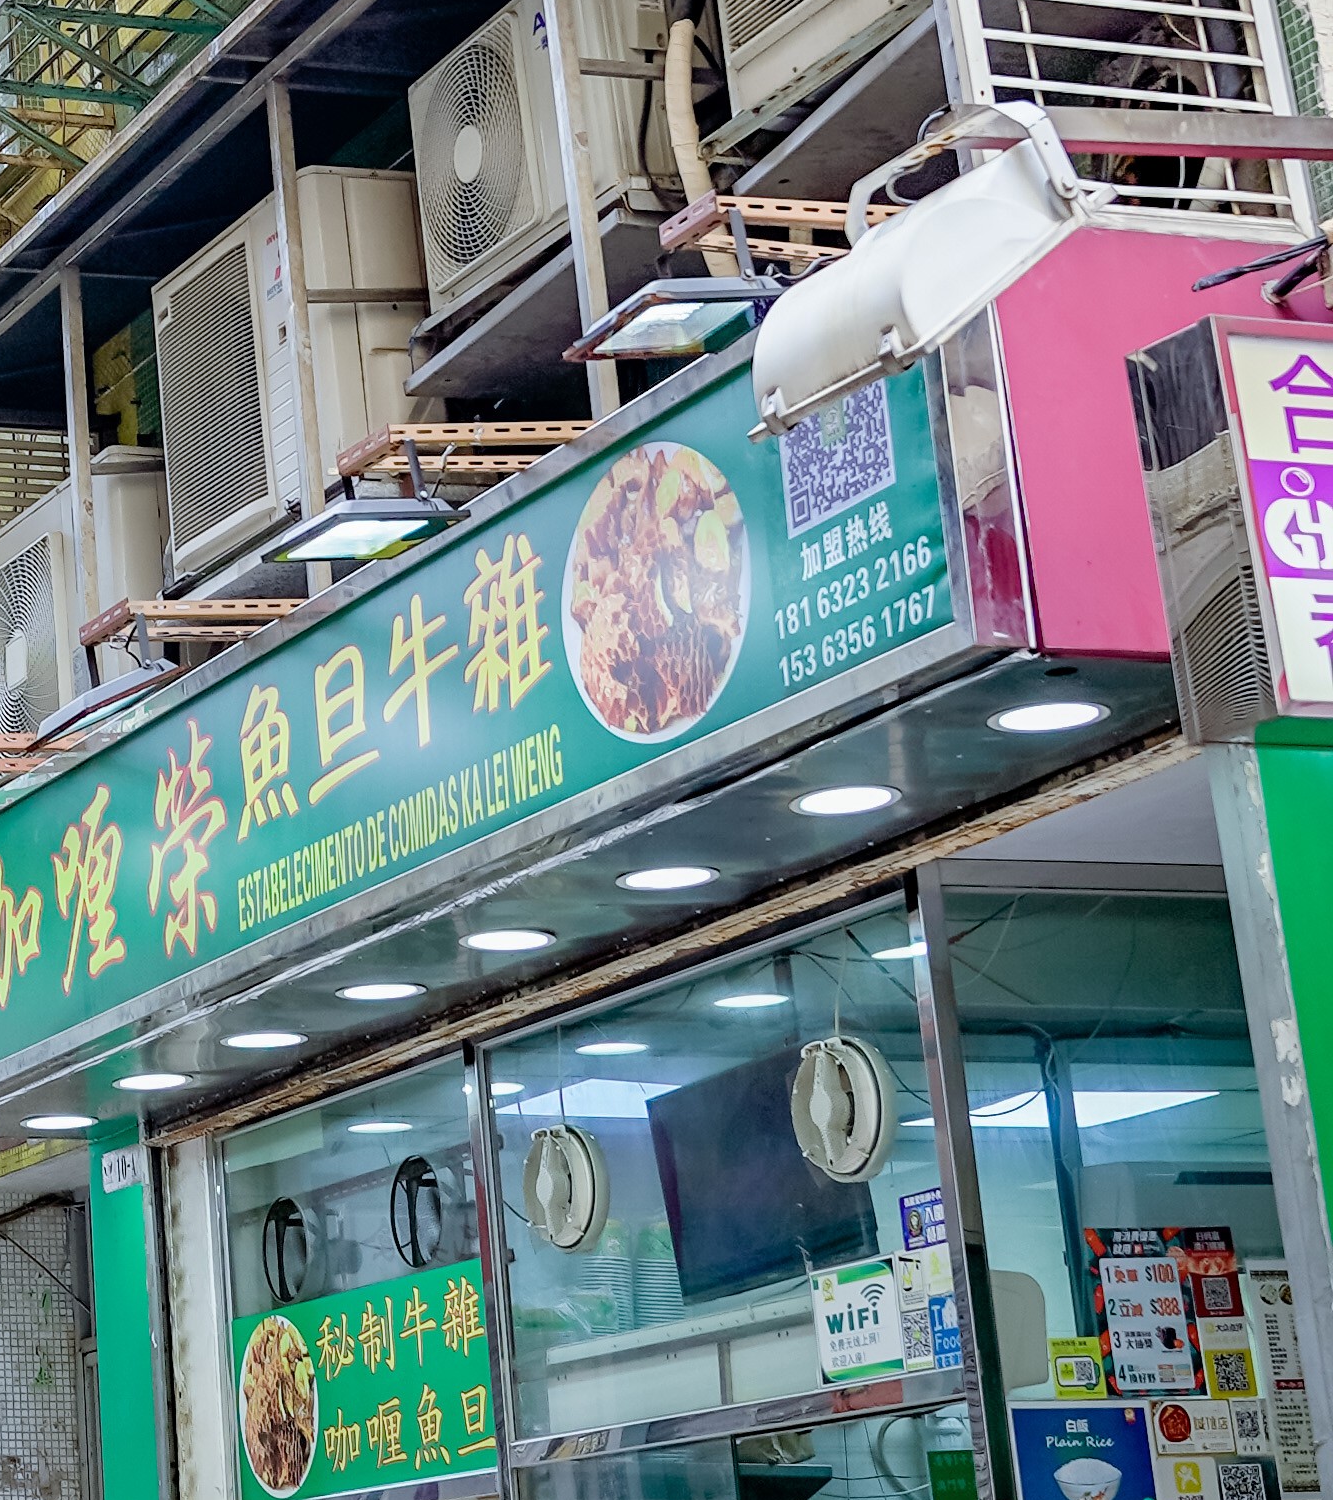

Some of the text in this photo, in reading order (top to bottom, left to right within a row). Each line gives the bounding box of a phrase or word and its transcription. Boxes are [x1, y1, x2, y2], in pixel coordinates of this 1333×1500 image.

[774, 535, 932, 640] 181 6323 2166
[800, 500, 892, 581] 加盟热线
[778, 584, 935, 686] 153 6356 1767
[238, 723, 563, 932] ESTABELECIMENTO DE COMIDAS KA LEI WENG
[315, 1276, 485, 1381] 秘制牛雜
[323, 1383, 496, 1472] 咖喱魚旦
[1045, 1435, 1115, 1448] Plain Rice
